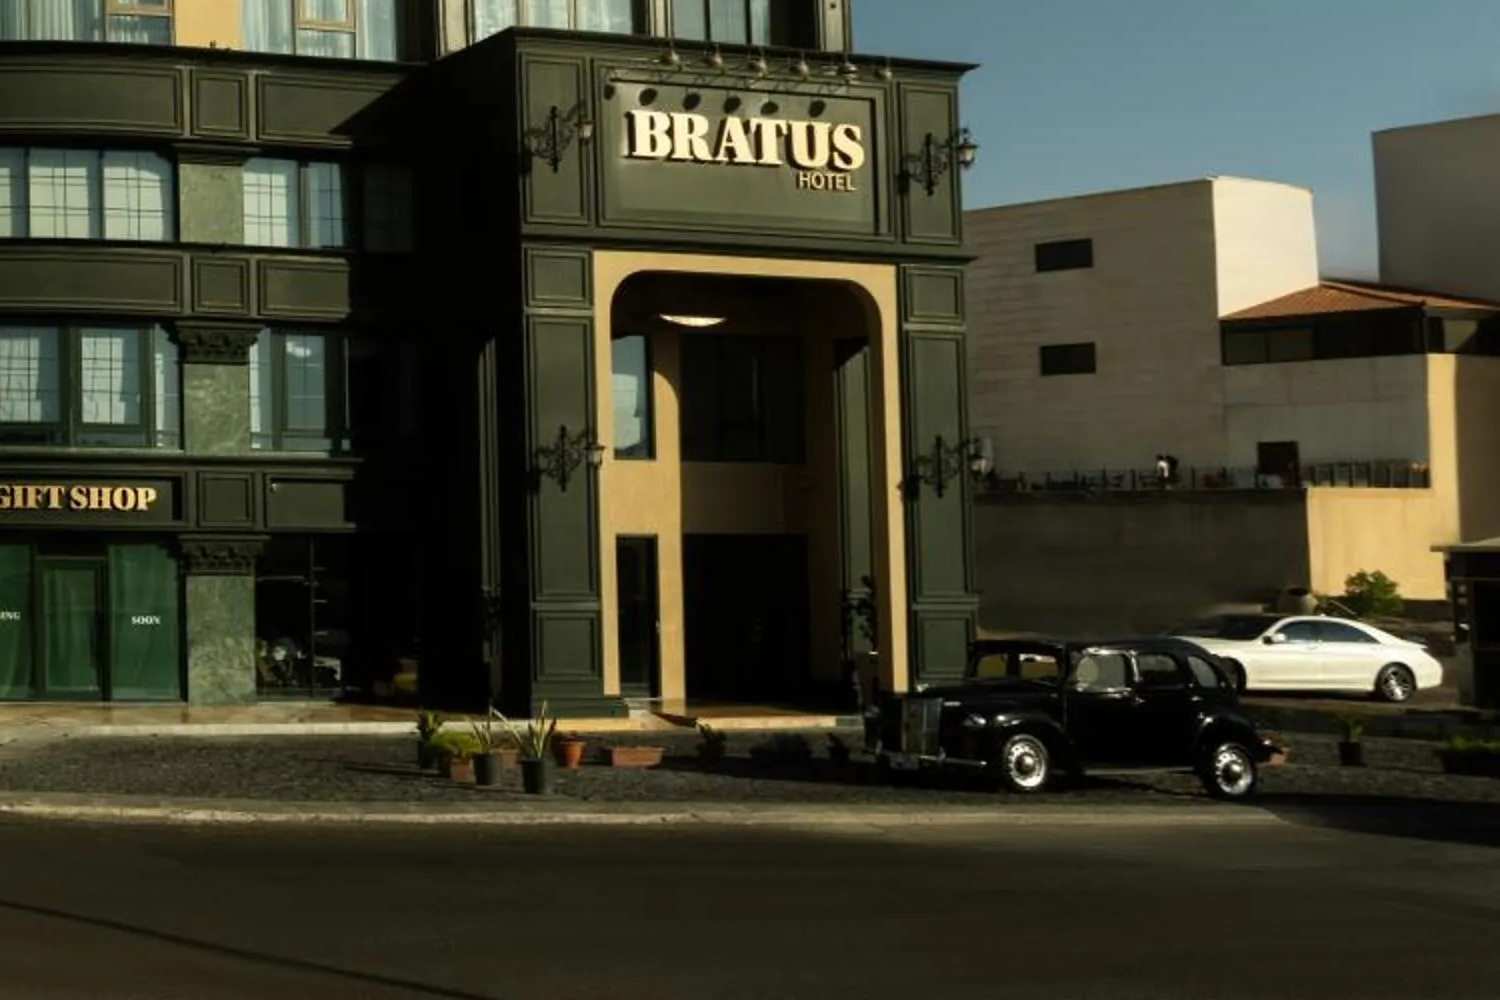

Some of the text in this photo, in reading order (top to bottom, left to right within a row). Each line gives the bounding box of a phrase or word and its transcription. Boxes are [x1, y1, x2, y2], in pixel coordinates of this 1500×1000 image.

[626, 108, 865, 171] BRATUS
[798, 170, 858, 191] HOTEL
[69, 485, 157, 511] SHOP
[131, 615, 161, 625] SOON
